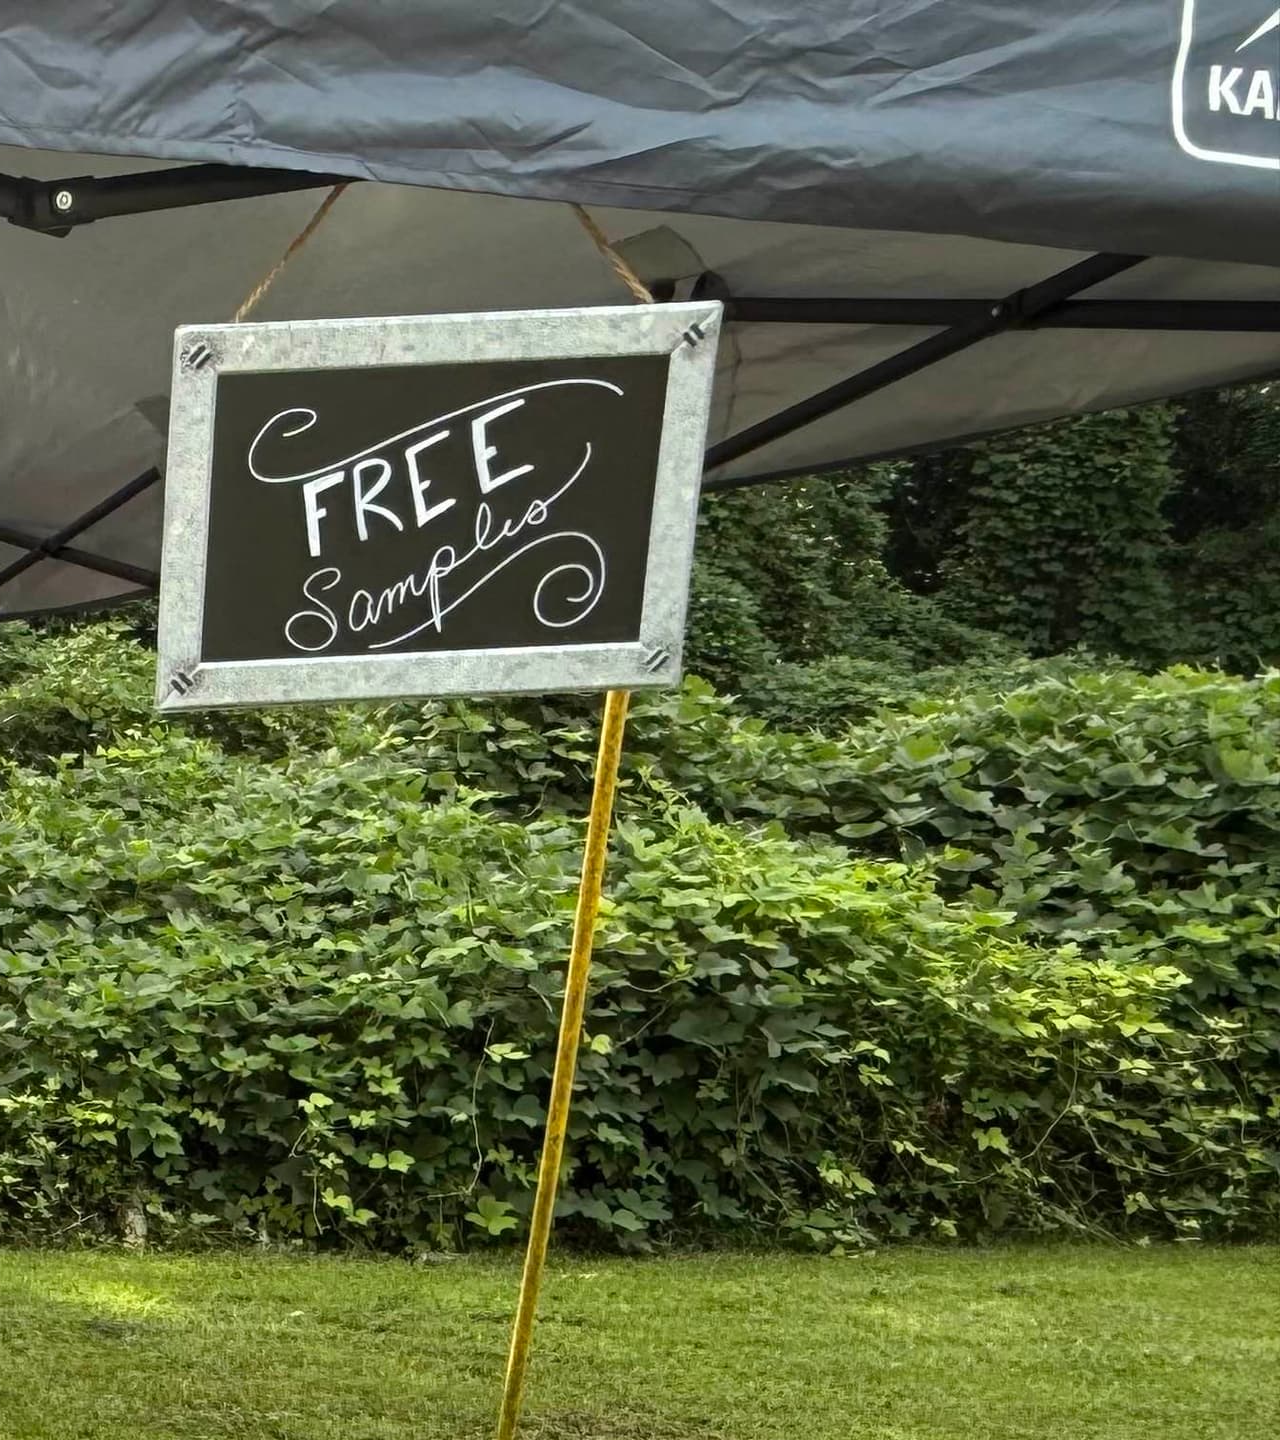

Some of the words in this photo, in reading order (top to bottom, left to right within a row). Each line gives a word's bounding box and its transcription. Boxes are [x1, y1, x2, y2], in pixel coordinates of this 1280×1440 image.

[1208, 64, 1280, 121] KA
[284, 442, 591, 652] Samples
[302, 398, 535, 558] FREE
